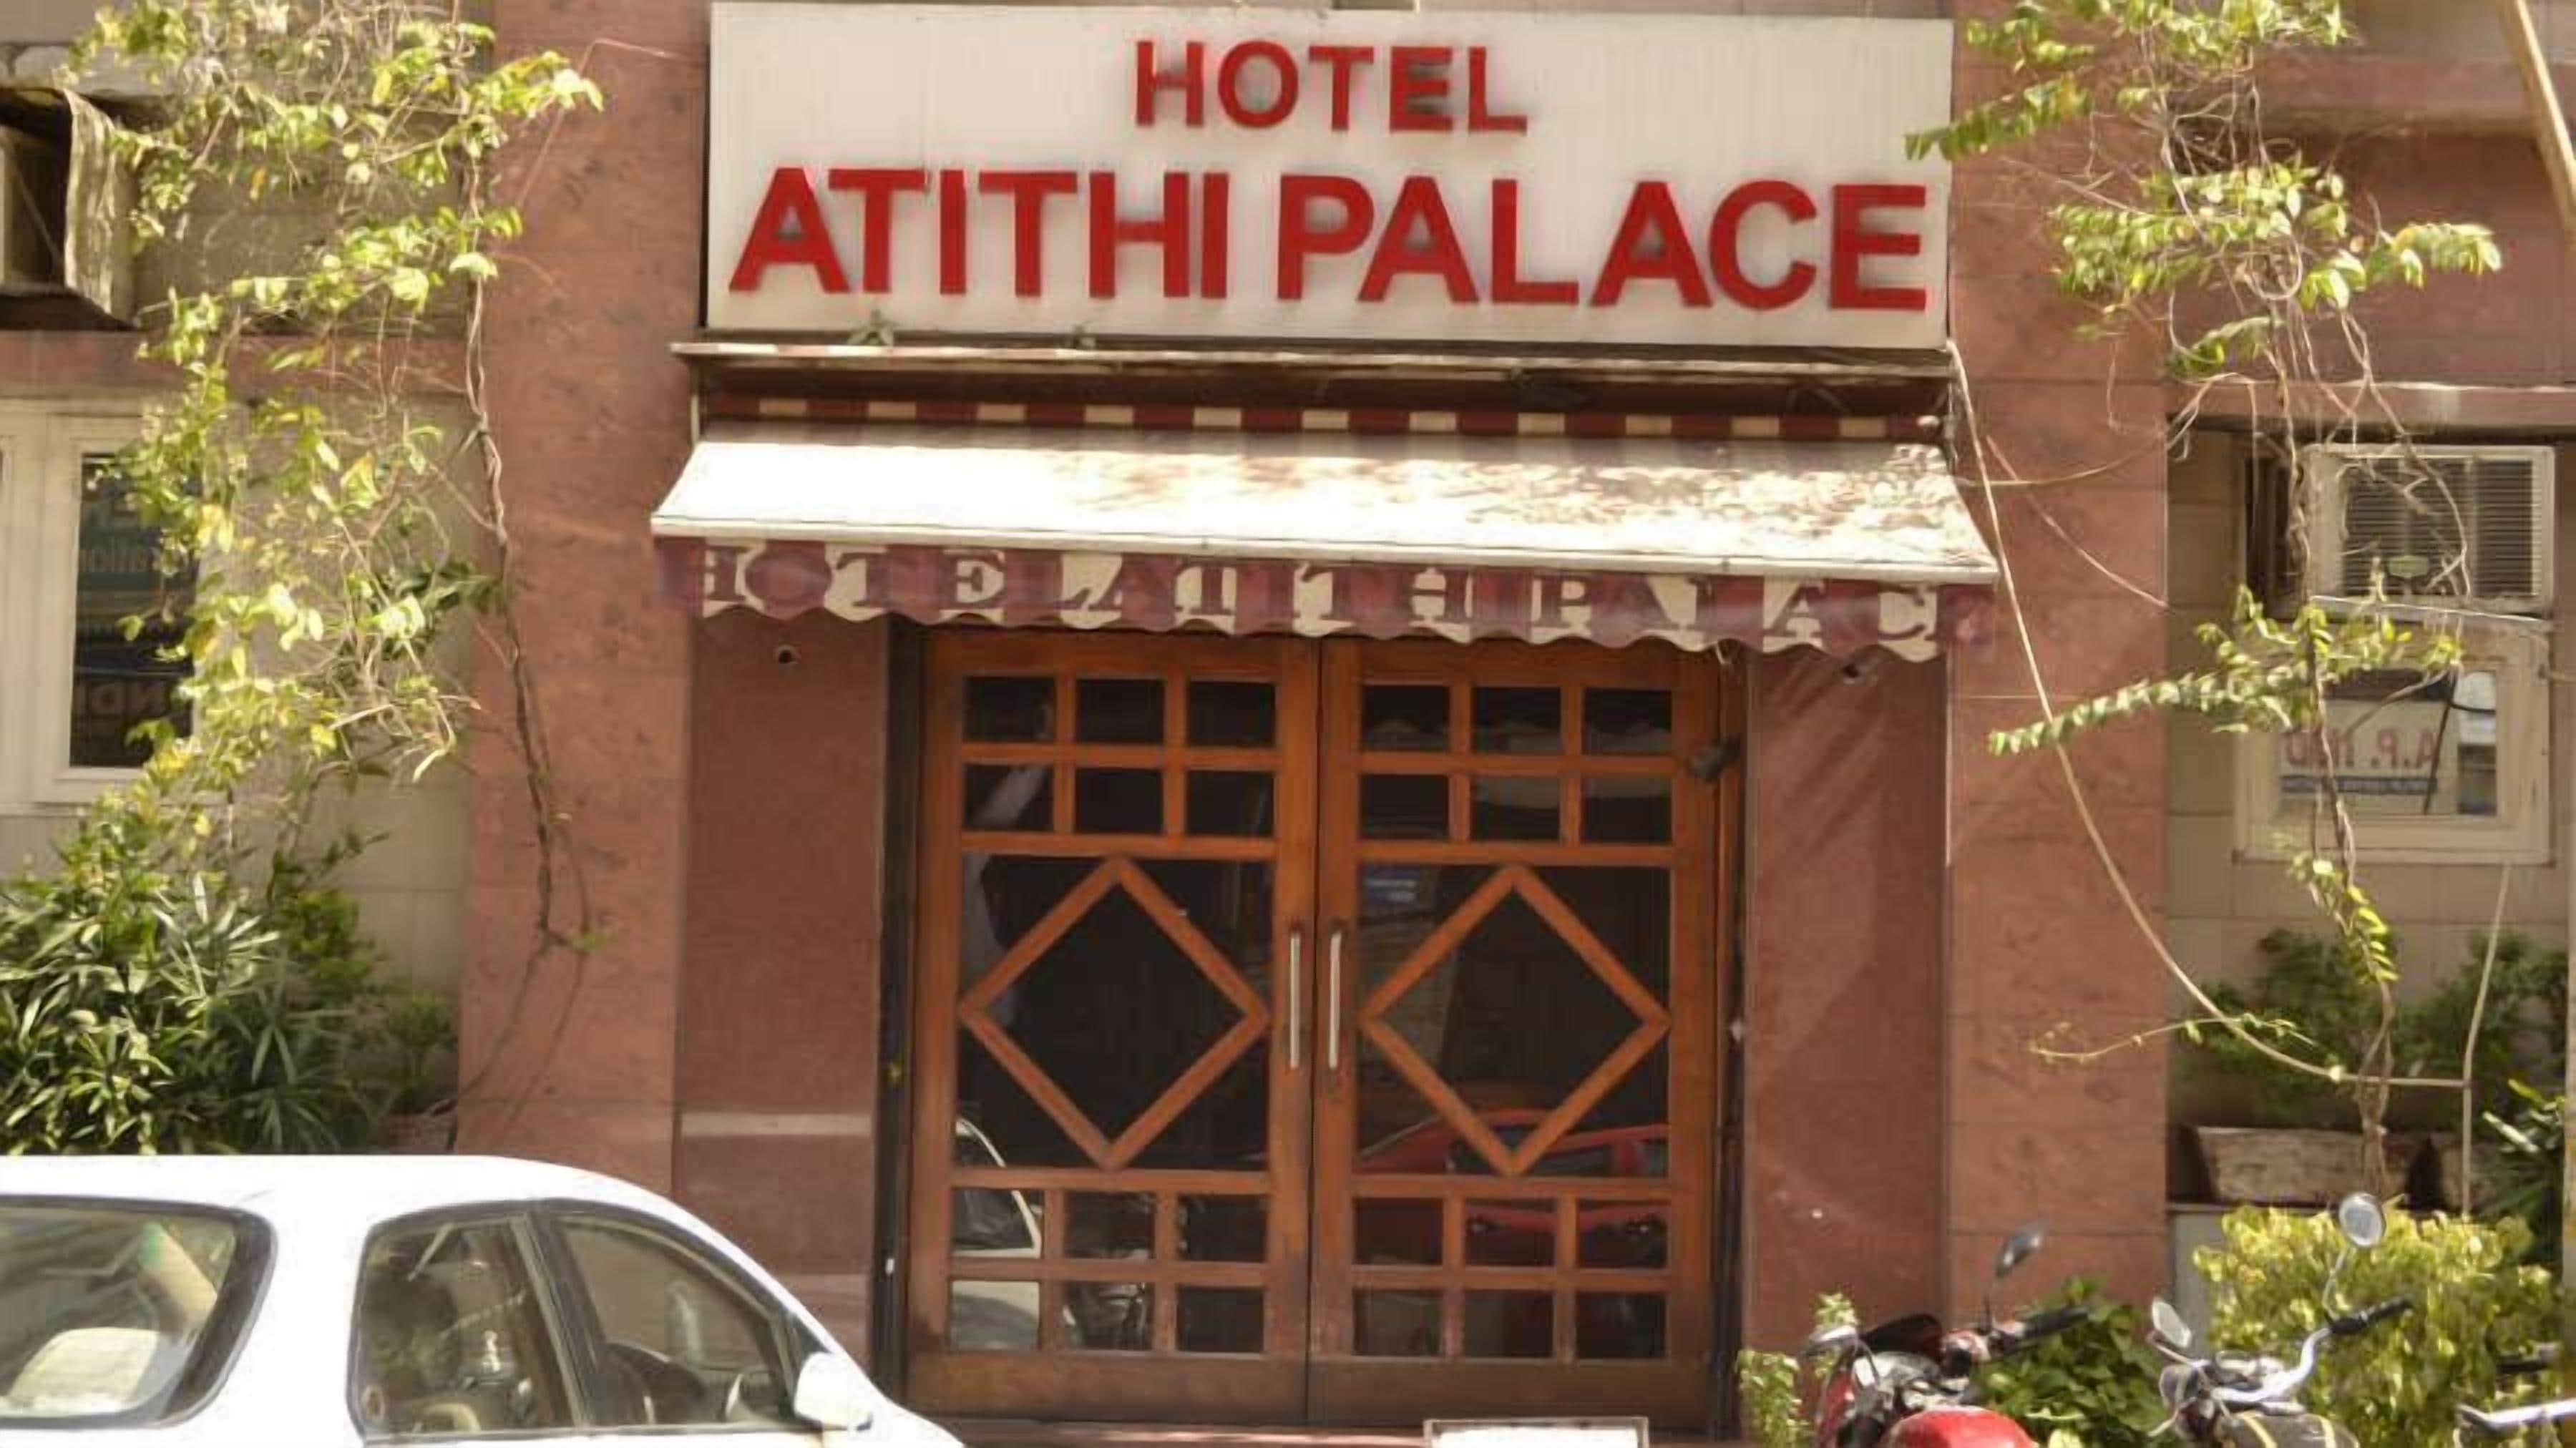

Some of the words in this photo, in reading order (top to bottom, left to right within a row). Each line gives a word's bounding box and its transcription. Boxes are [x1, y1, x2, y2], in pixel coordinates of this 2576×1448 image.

[1133, 37, 1527, 134] HOTEL
[730, 165, 1228, 300] ATITHI
[1275, 173, 1928, 313] PALACE
